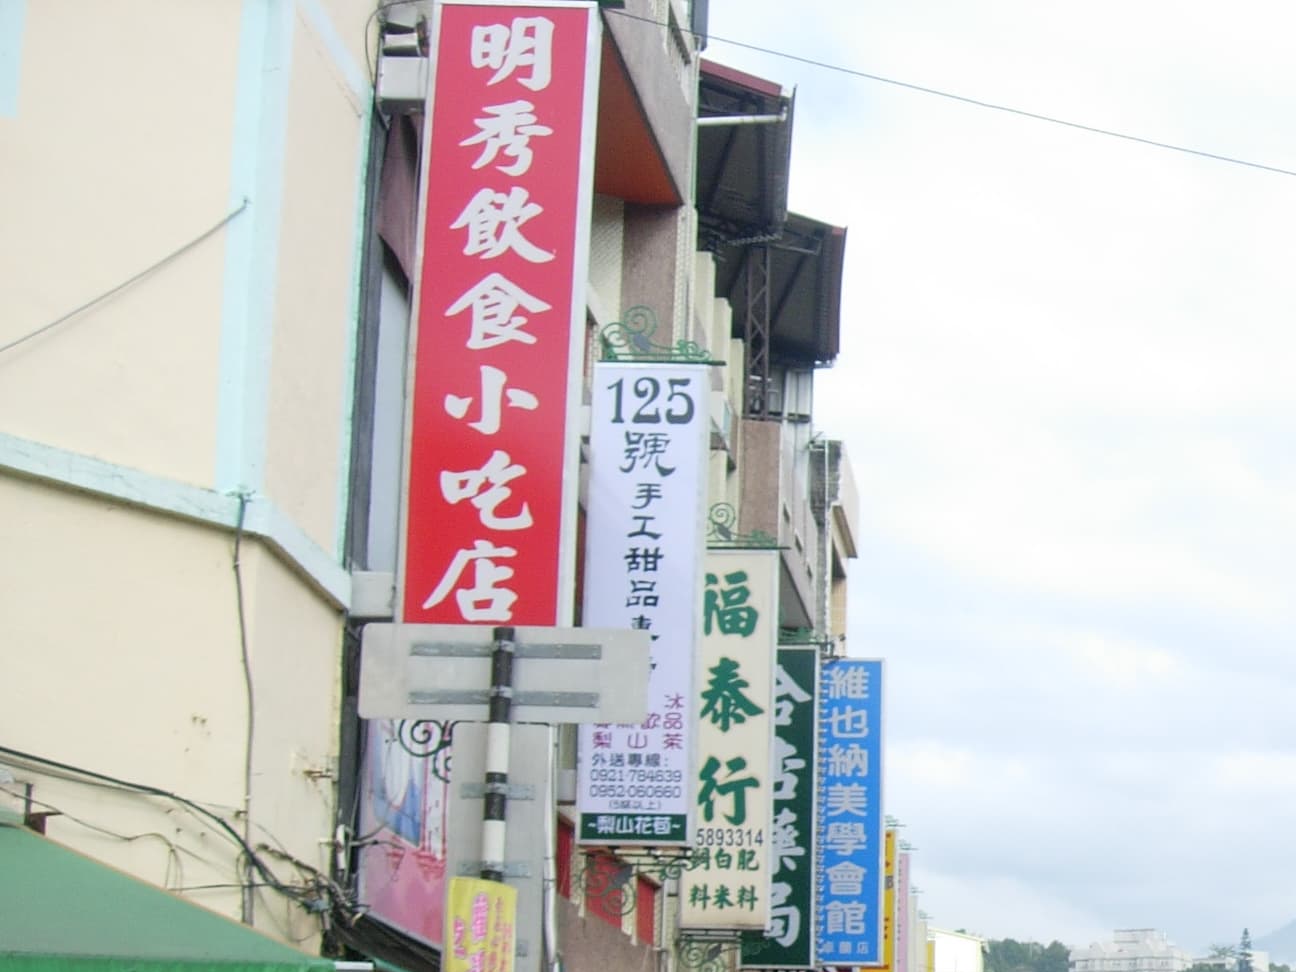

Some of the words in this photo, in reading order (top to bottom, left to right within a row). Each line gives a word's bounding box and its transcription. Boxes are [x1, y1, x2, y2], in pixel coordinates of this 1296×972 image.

[424, 16, 557, 624] 明秀飲食小吃店
[607, 376, 696, 425] 125
[698, 572, 765, 826] 福泰行
[826, 666, 871, 935] 維也納美學會館
